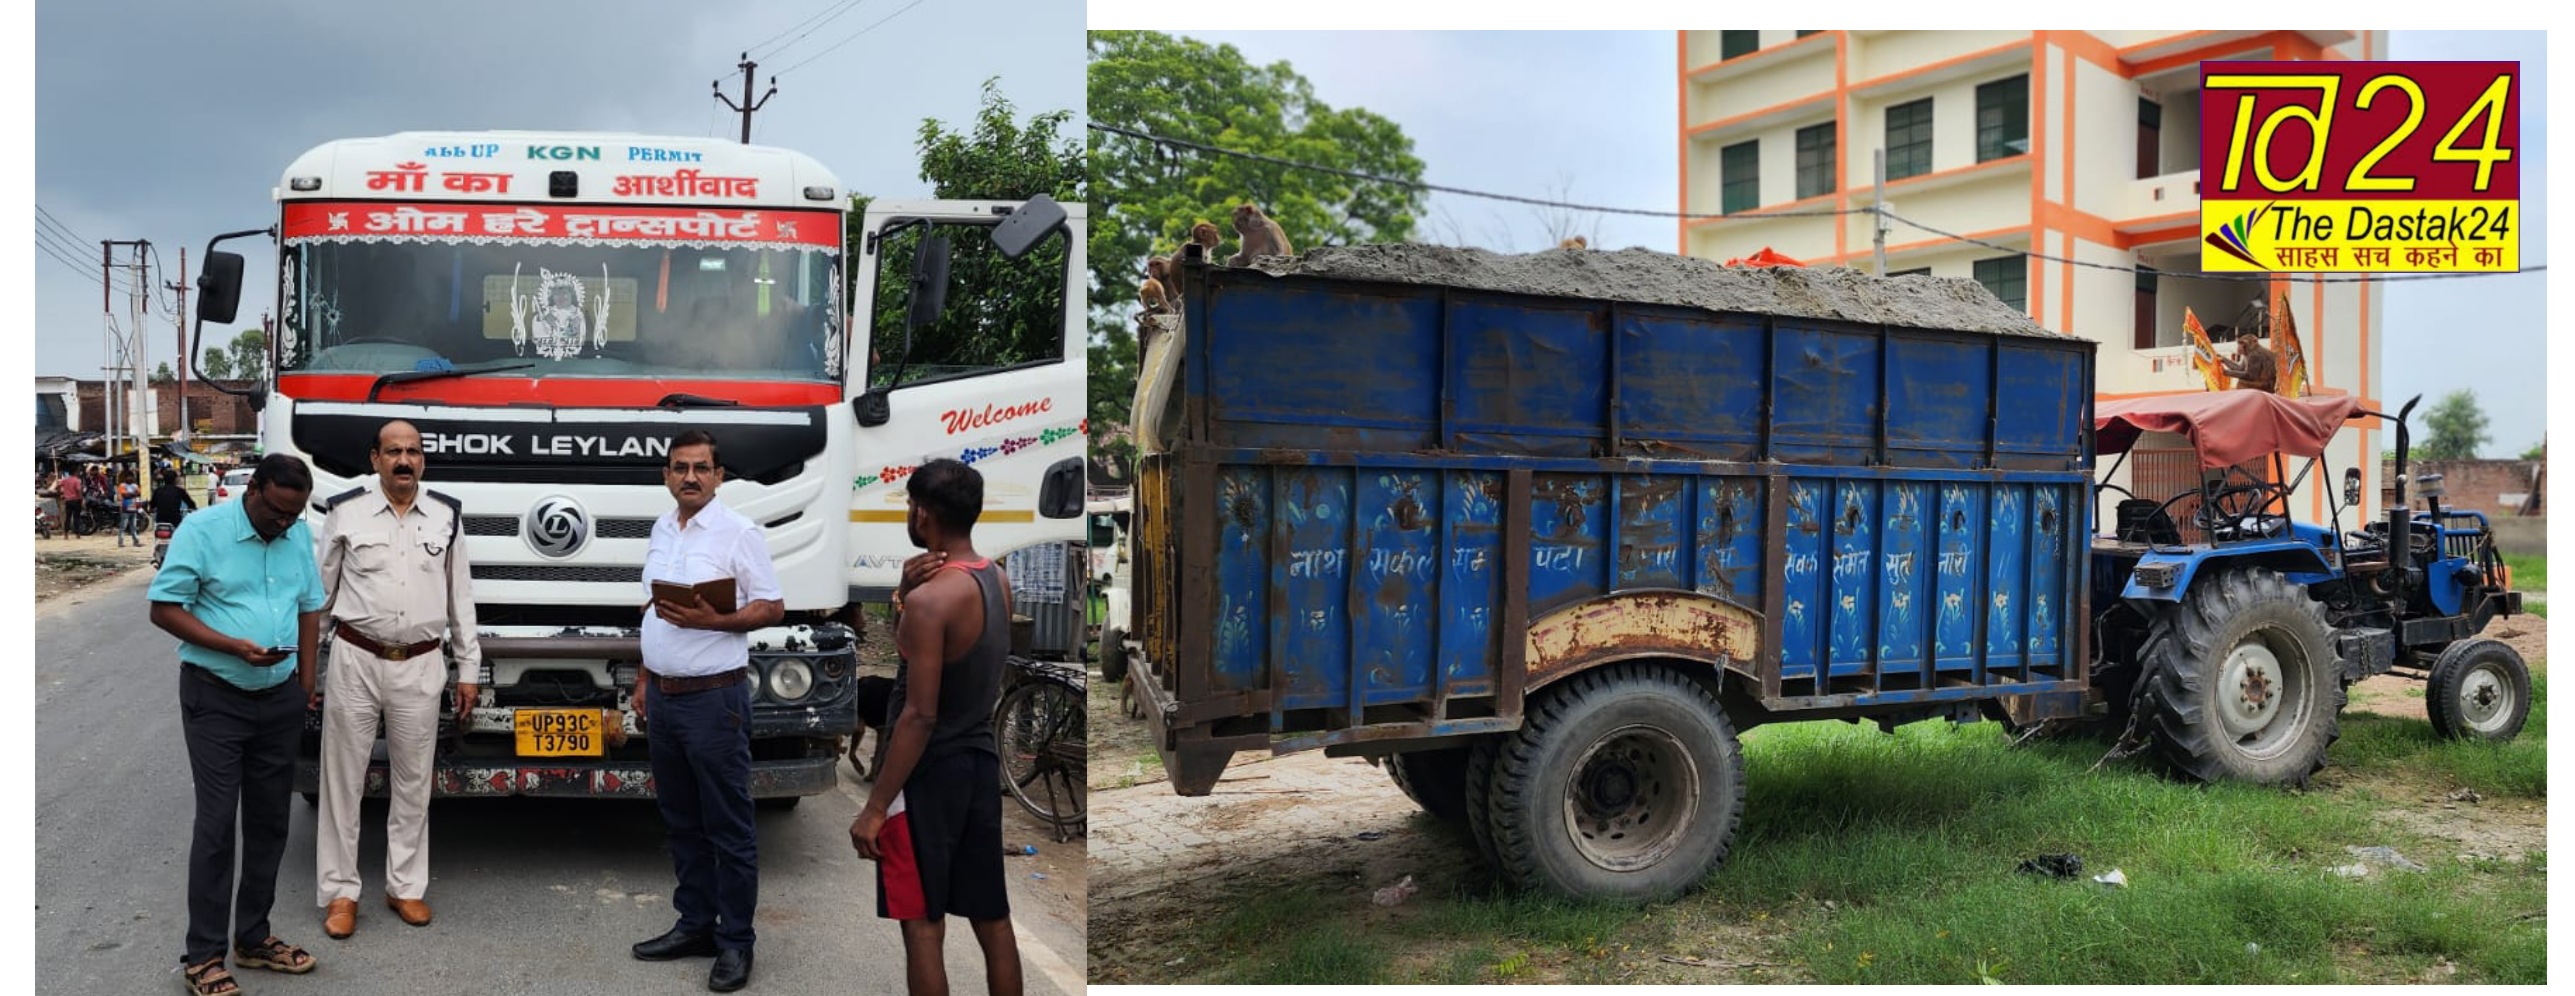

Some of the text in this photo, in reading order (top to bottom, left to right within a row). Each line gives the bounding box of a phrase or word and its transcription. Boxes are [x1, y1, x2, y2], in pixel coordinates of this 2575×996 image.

[471, 143, 500, 158] UP
[528, 145, 601, 161] KGN
[628, 146, 703, 162] PERMIT
[366, 161, 429, 193] माँ
[441, 171, 513, 194] का
[364, 206, 469, 233] ओम
[481, 206, 549, 233] हरे
[940, 396, 1053, 436] Welcome
[420, 432, 672, 458] SHOK LEYLAN
[853, 554, 903, 569] AVT
[532, 714, 589, 732] UP93C
[533, 734, 589, 752] T3790
